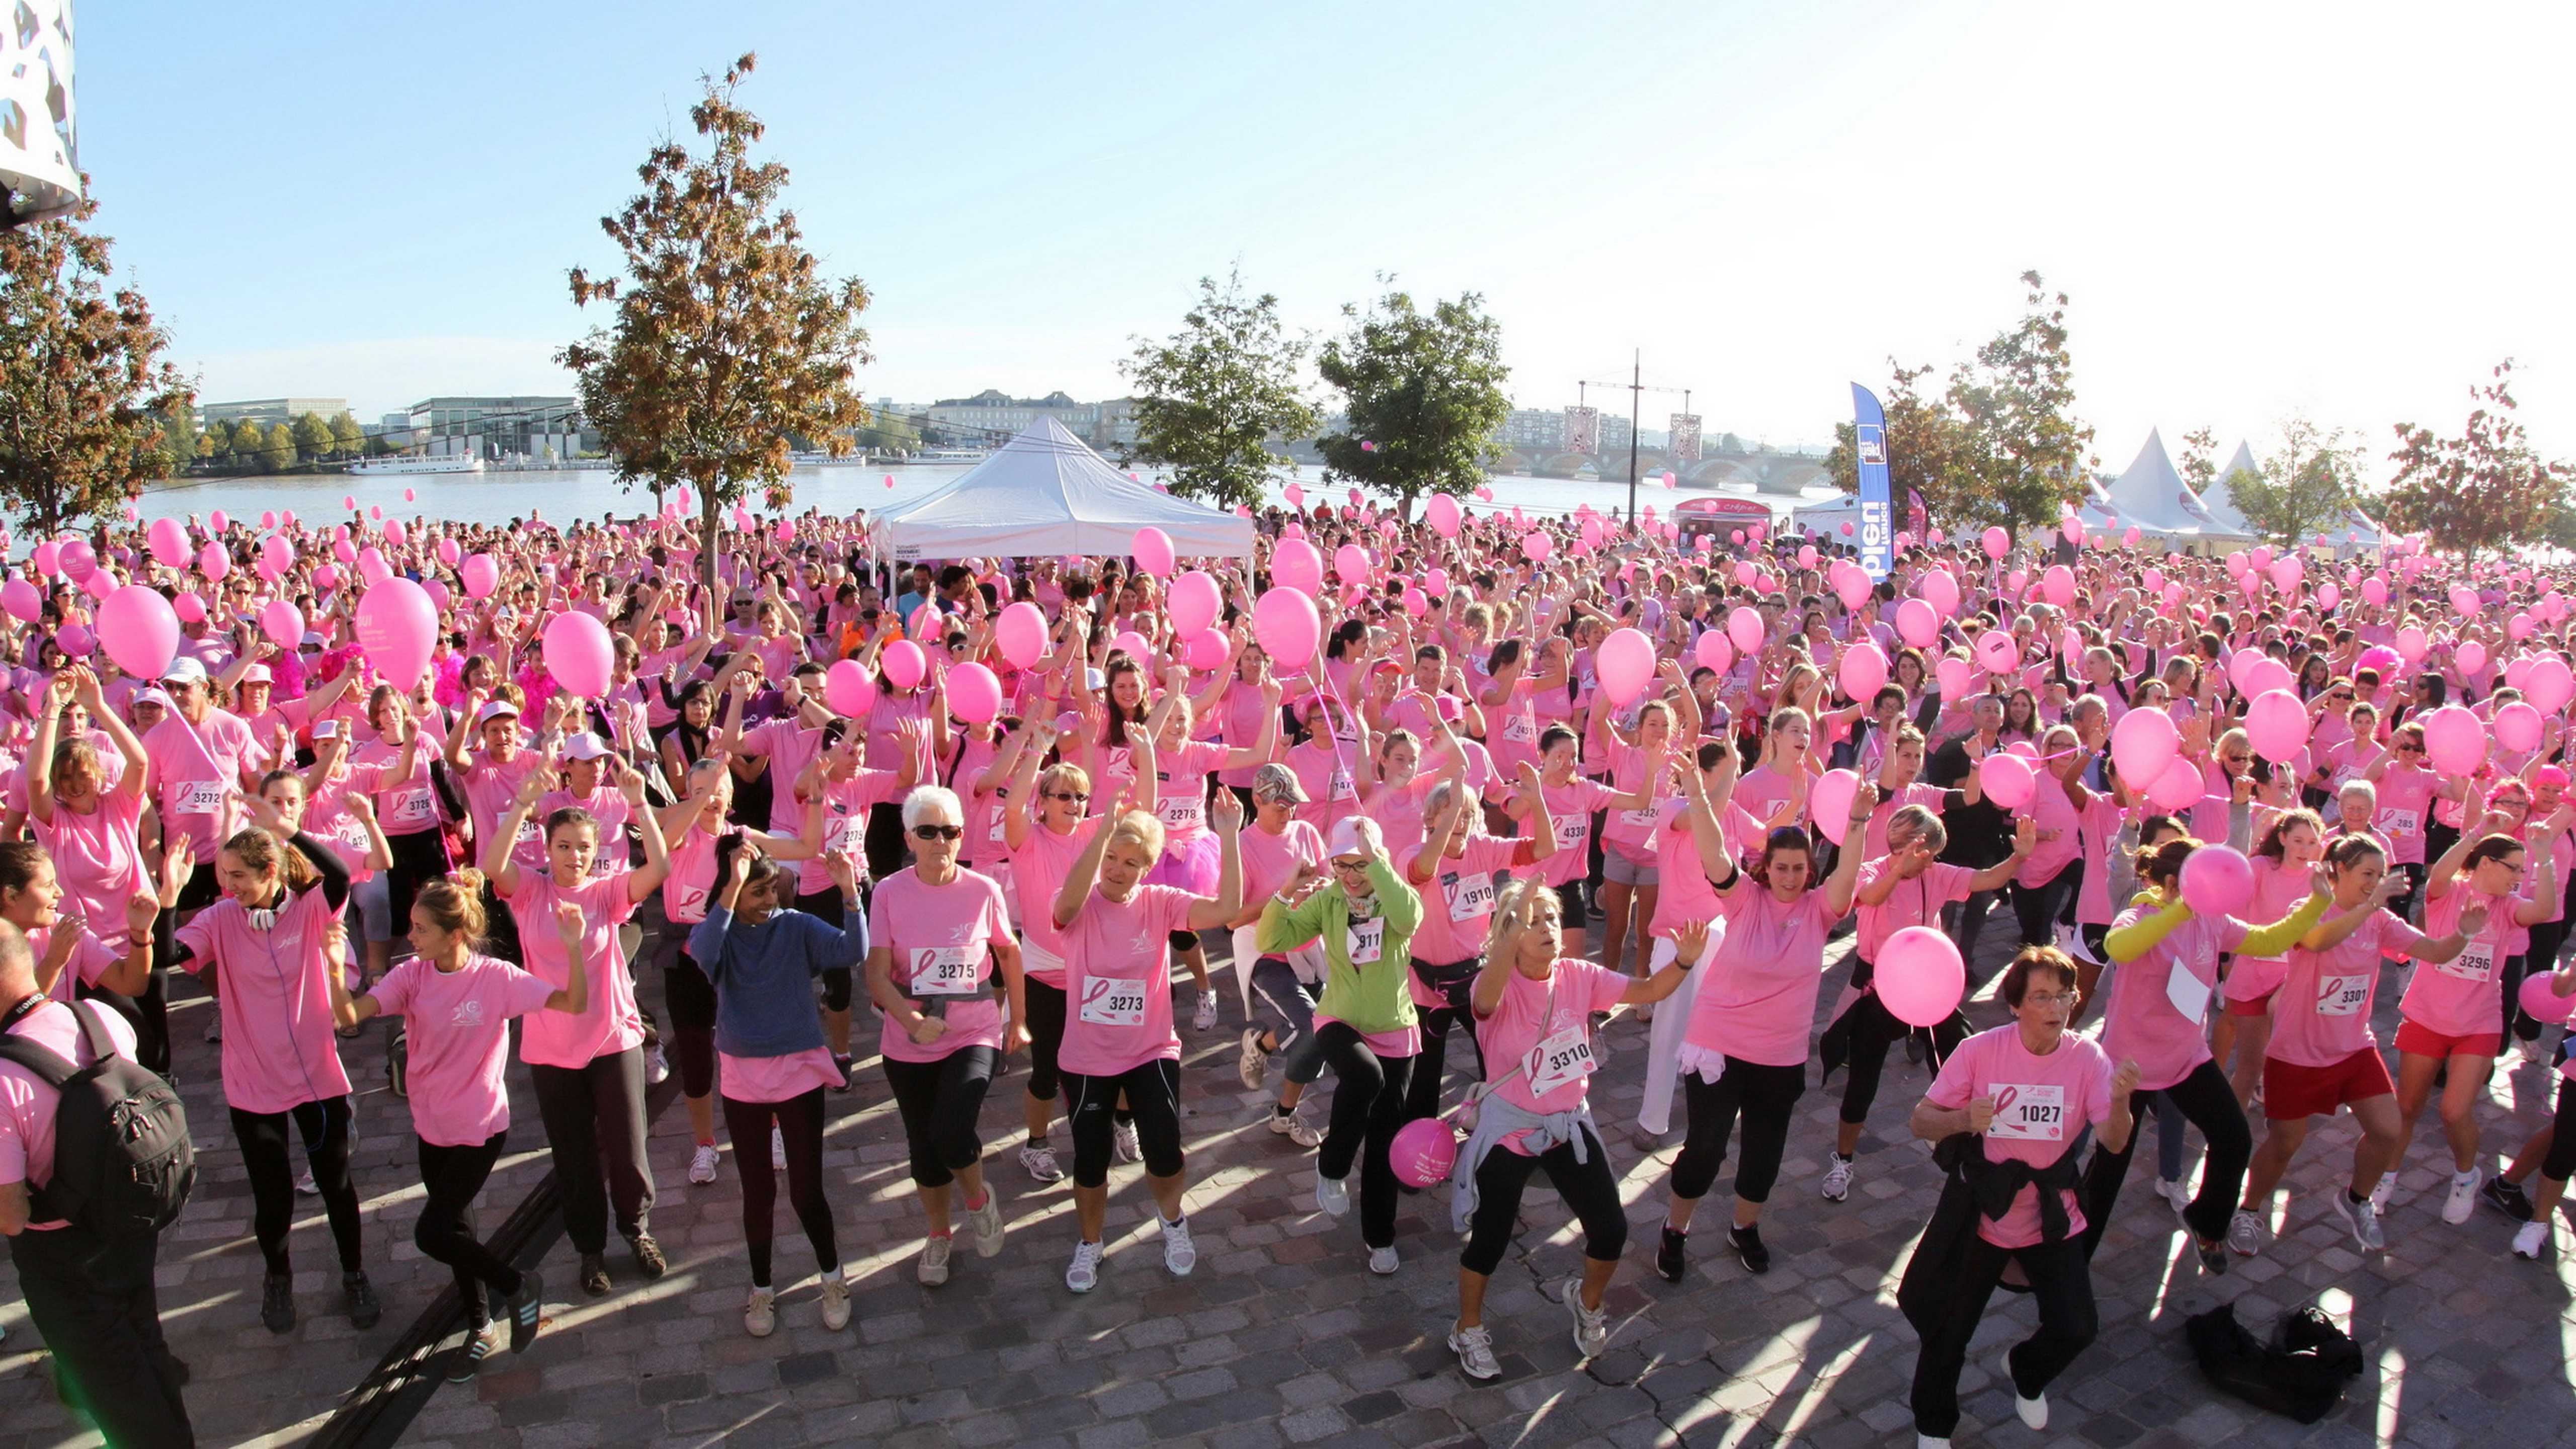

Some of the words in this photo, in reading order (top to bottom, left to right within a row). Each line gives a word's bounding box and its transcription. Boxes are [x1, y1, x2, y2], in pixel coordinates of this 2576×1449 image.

[194, 792, 220, 803] 3272
[1170, 809, 1196, 820] 2278
[2397, 819, 2413, 828] 285
[1564, 826, 1585, 838] 4330
[1463, 887, 1492, 905] 1910
[2459, 955, 2490, 970] 3296
[939, 964, 975, 979] 3275
[2342, 989, 2366, 1003] 3301
[15, 993, 45, 1014] Canon
[1109, 997, 1143, 1011] 3273
[1550, 1043, 1589, 1071] 3310
[2020, 1105, 2061, 1122] 1027
